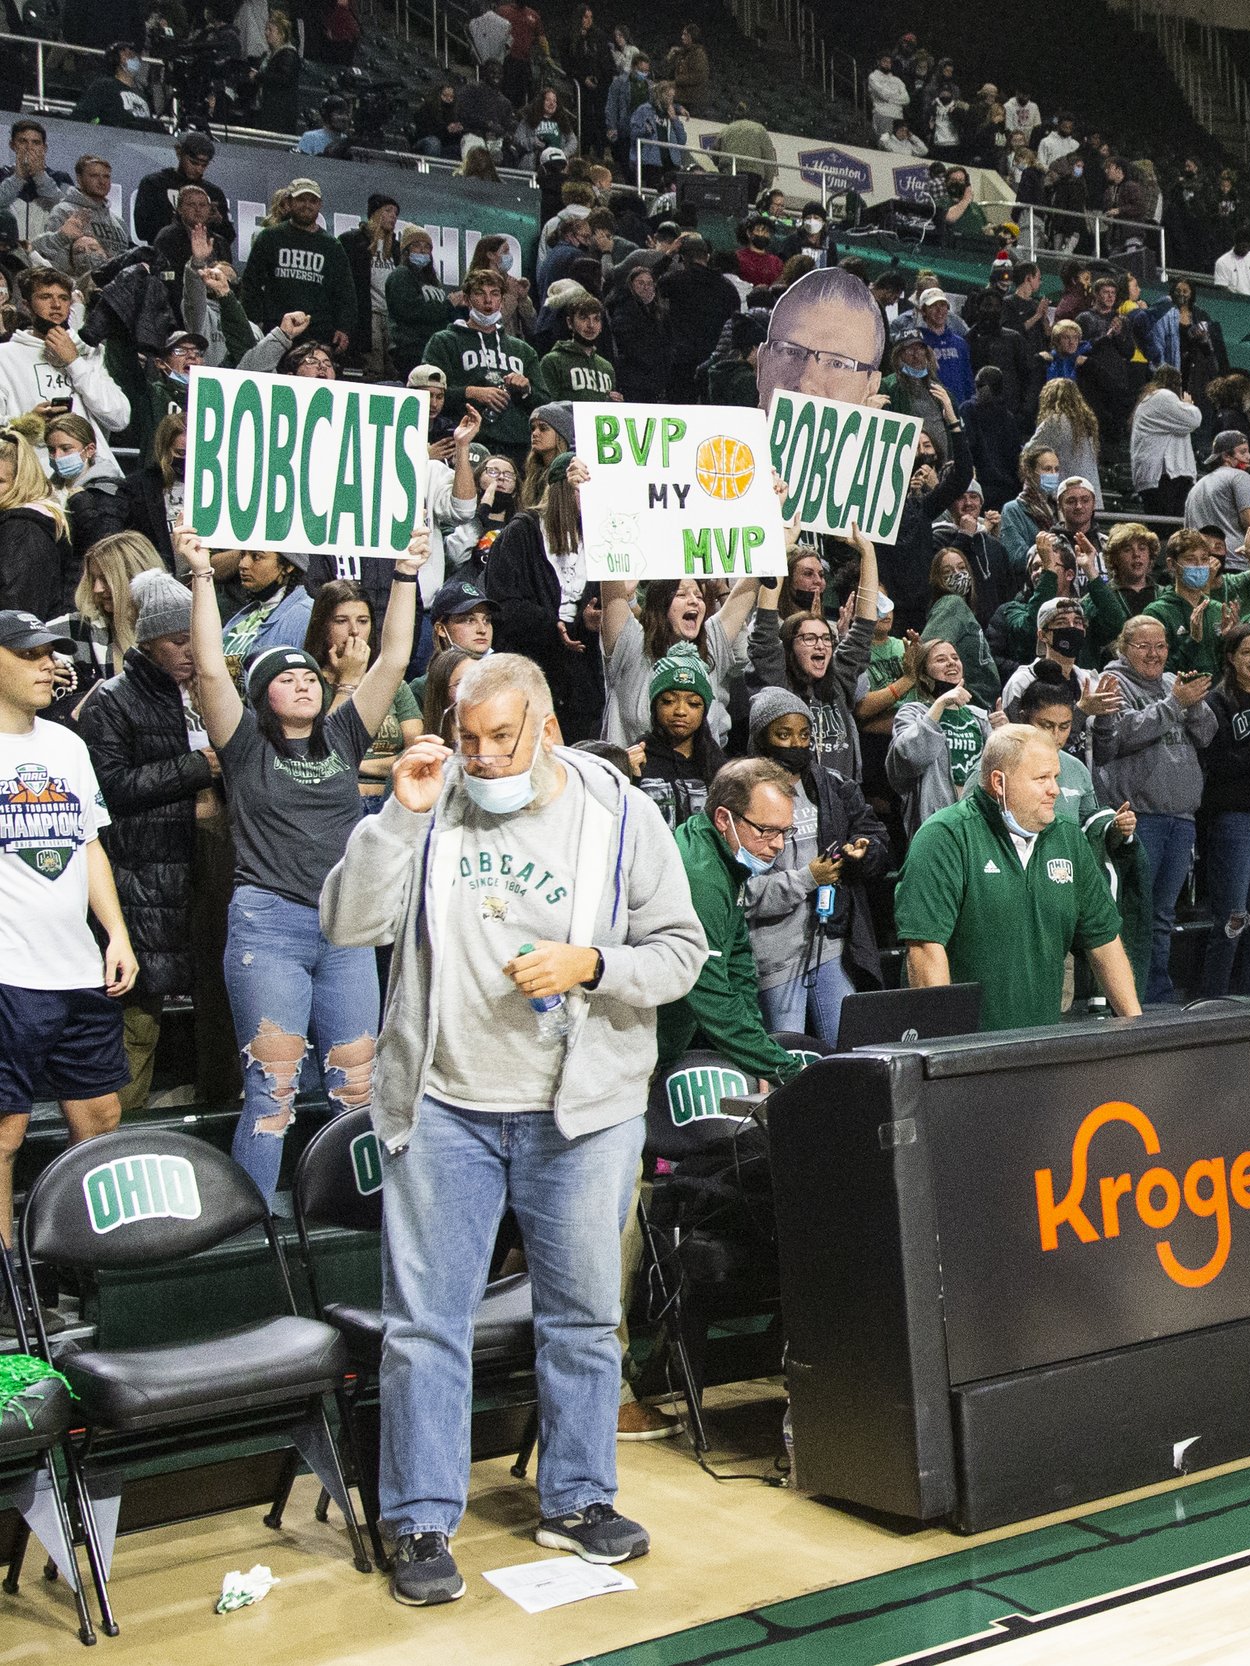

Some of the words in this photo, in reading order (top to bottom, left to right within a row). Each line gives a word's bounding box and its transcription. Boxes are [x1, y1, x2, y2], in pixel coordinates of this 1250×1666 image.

[827, 174, 849, 190] Inn
[278, 248, 325, 273] OHIO
[462, 350, 524, 376] OHIO
[569, 367, 613, 394] OHIO
[594, 415, 687, 468] BVP
[192, 376, 421, 552] BOBCATS
[769, 397, 917, 538] BOBCATS
[648, 483, 691, 509] MY
[606, 551, 631, 573] OHIO
[682, 526, 766, 575] MVP
[20, 772, 48, 780] MAC
[54, 779, 71, 793] 21
[26, 802, 80, 813] TOURNAMENT
[0, 811, 85, 840] HAMPIONS
[452, 851, 568, 905] OBCATS
[1048, 860, 1073, 878] OHIO
[468, 877, 500, 890] SINCE
[504, 880, 529, 897] 1804
[84, 1155, 201, 1233] OHIO
